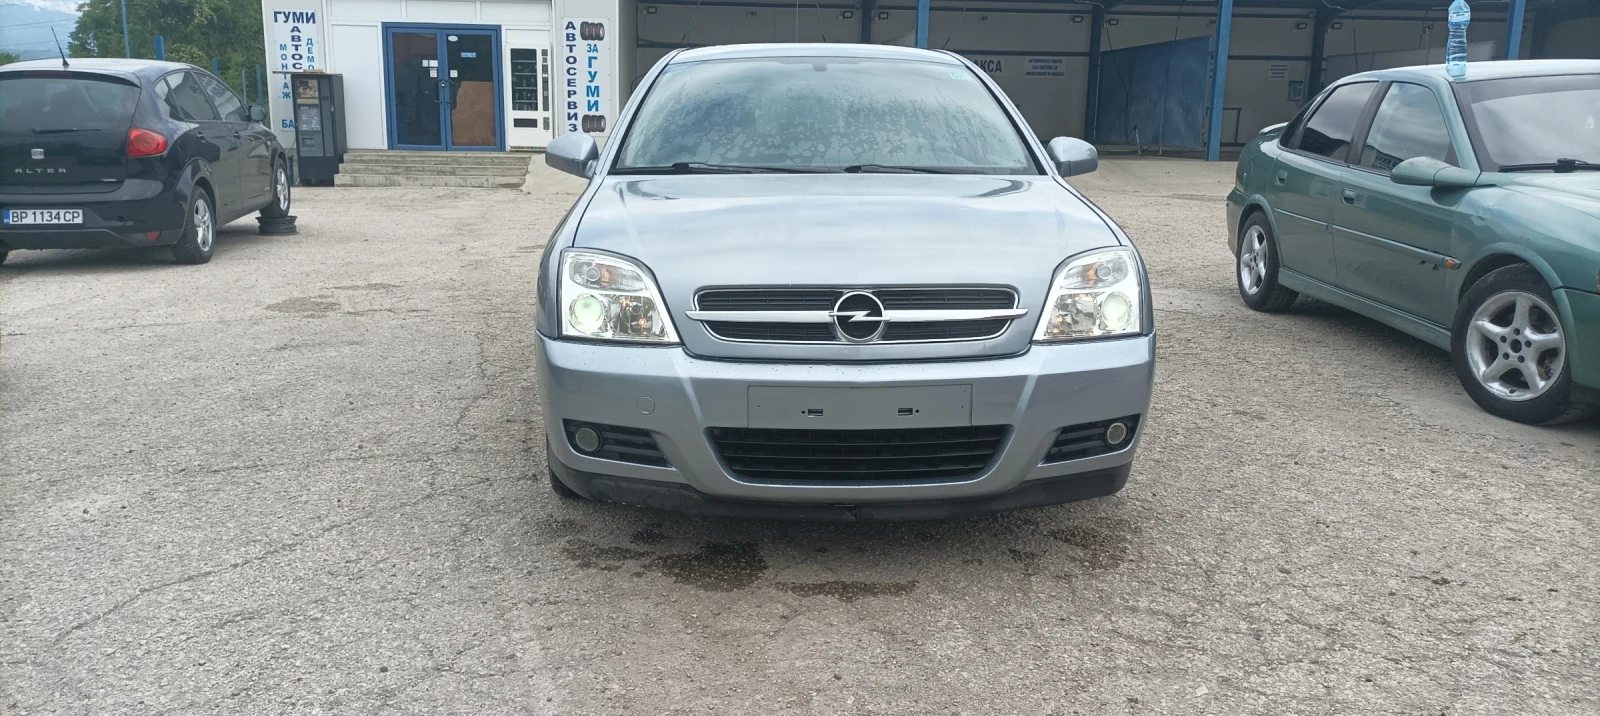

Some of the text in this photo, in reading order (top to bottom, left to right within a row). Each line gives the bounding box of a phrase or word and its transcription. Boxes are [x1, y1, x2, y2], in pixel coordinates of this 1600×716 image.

[274, 11, 316, 24] ГУМИ
[586, 44, 598, 53] ЗА
[565, 21, 578, 132] АВТОСЕРВИЗ
[586, 56, 600, 112] ГУМИ
[32, 211, 61, 222] 1134
